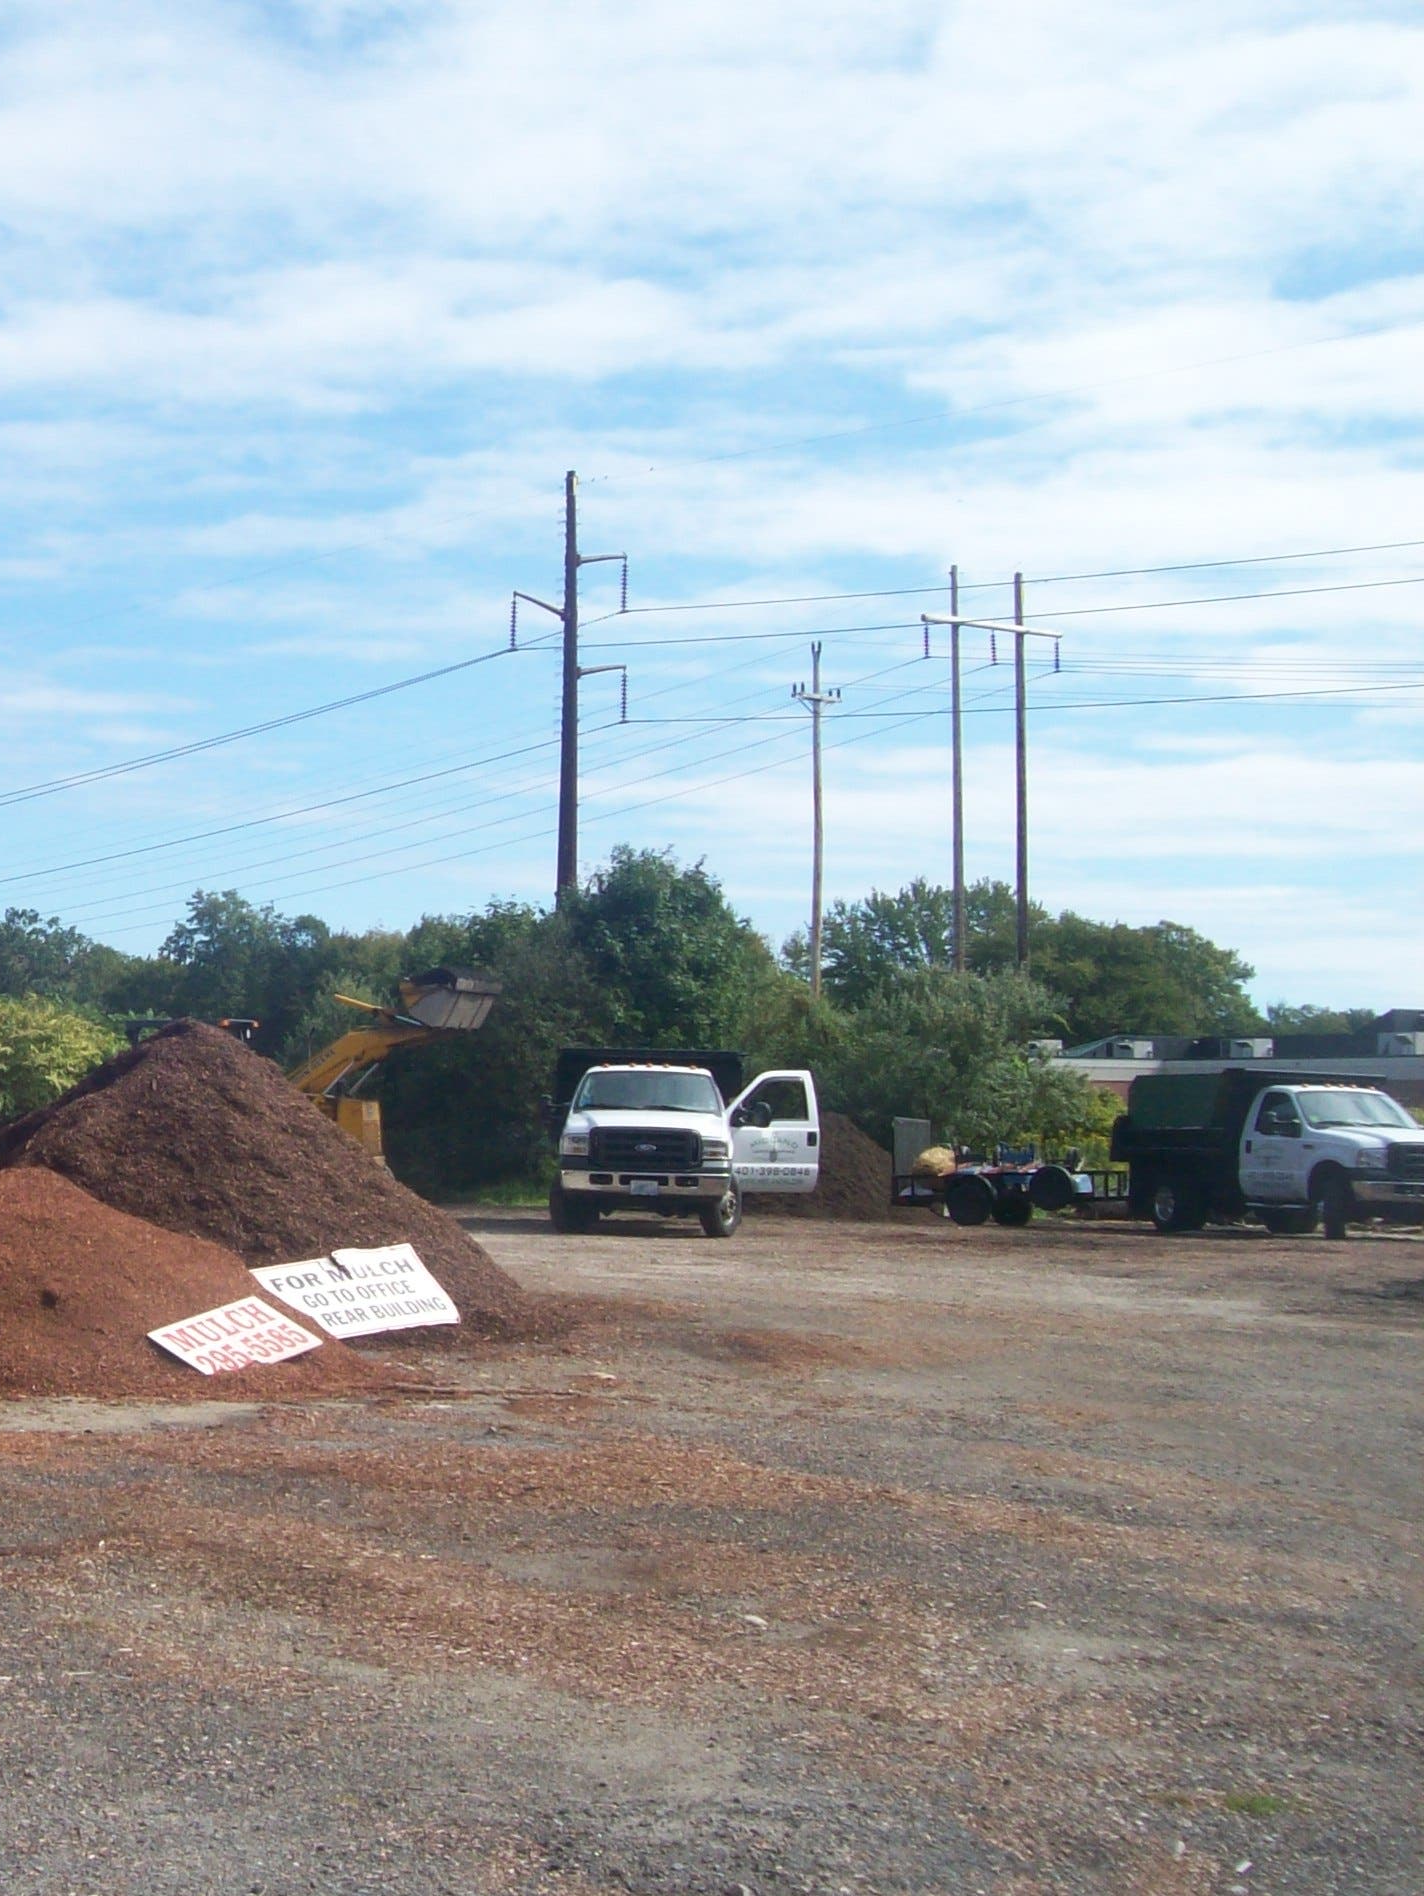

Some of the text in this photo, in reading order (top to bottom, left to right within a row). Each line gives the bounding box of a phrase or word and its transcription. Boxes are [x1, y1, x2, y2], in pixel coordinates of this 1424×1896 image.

[269, 1259, 415, 1292] FOR MULCH
[302, 1279, 416, 1309] GO TO OFFICE
[162, 1303, 275, 1352] MULCH
[321, 1296, 447, 1329] REAR BUILDING
